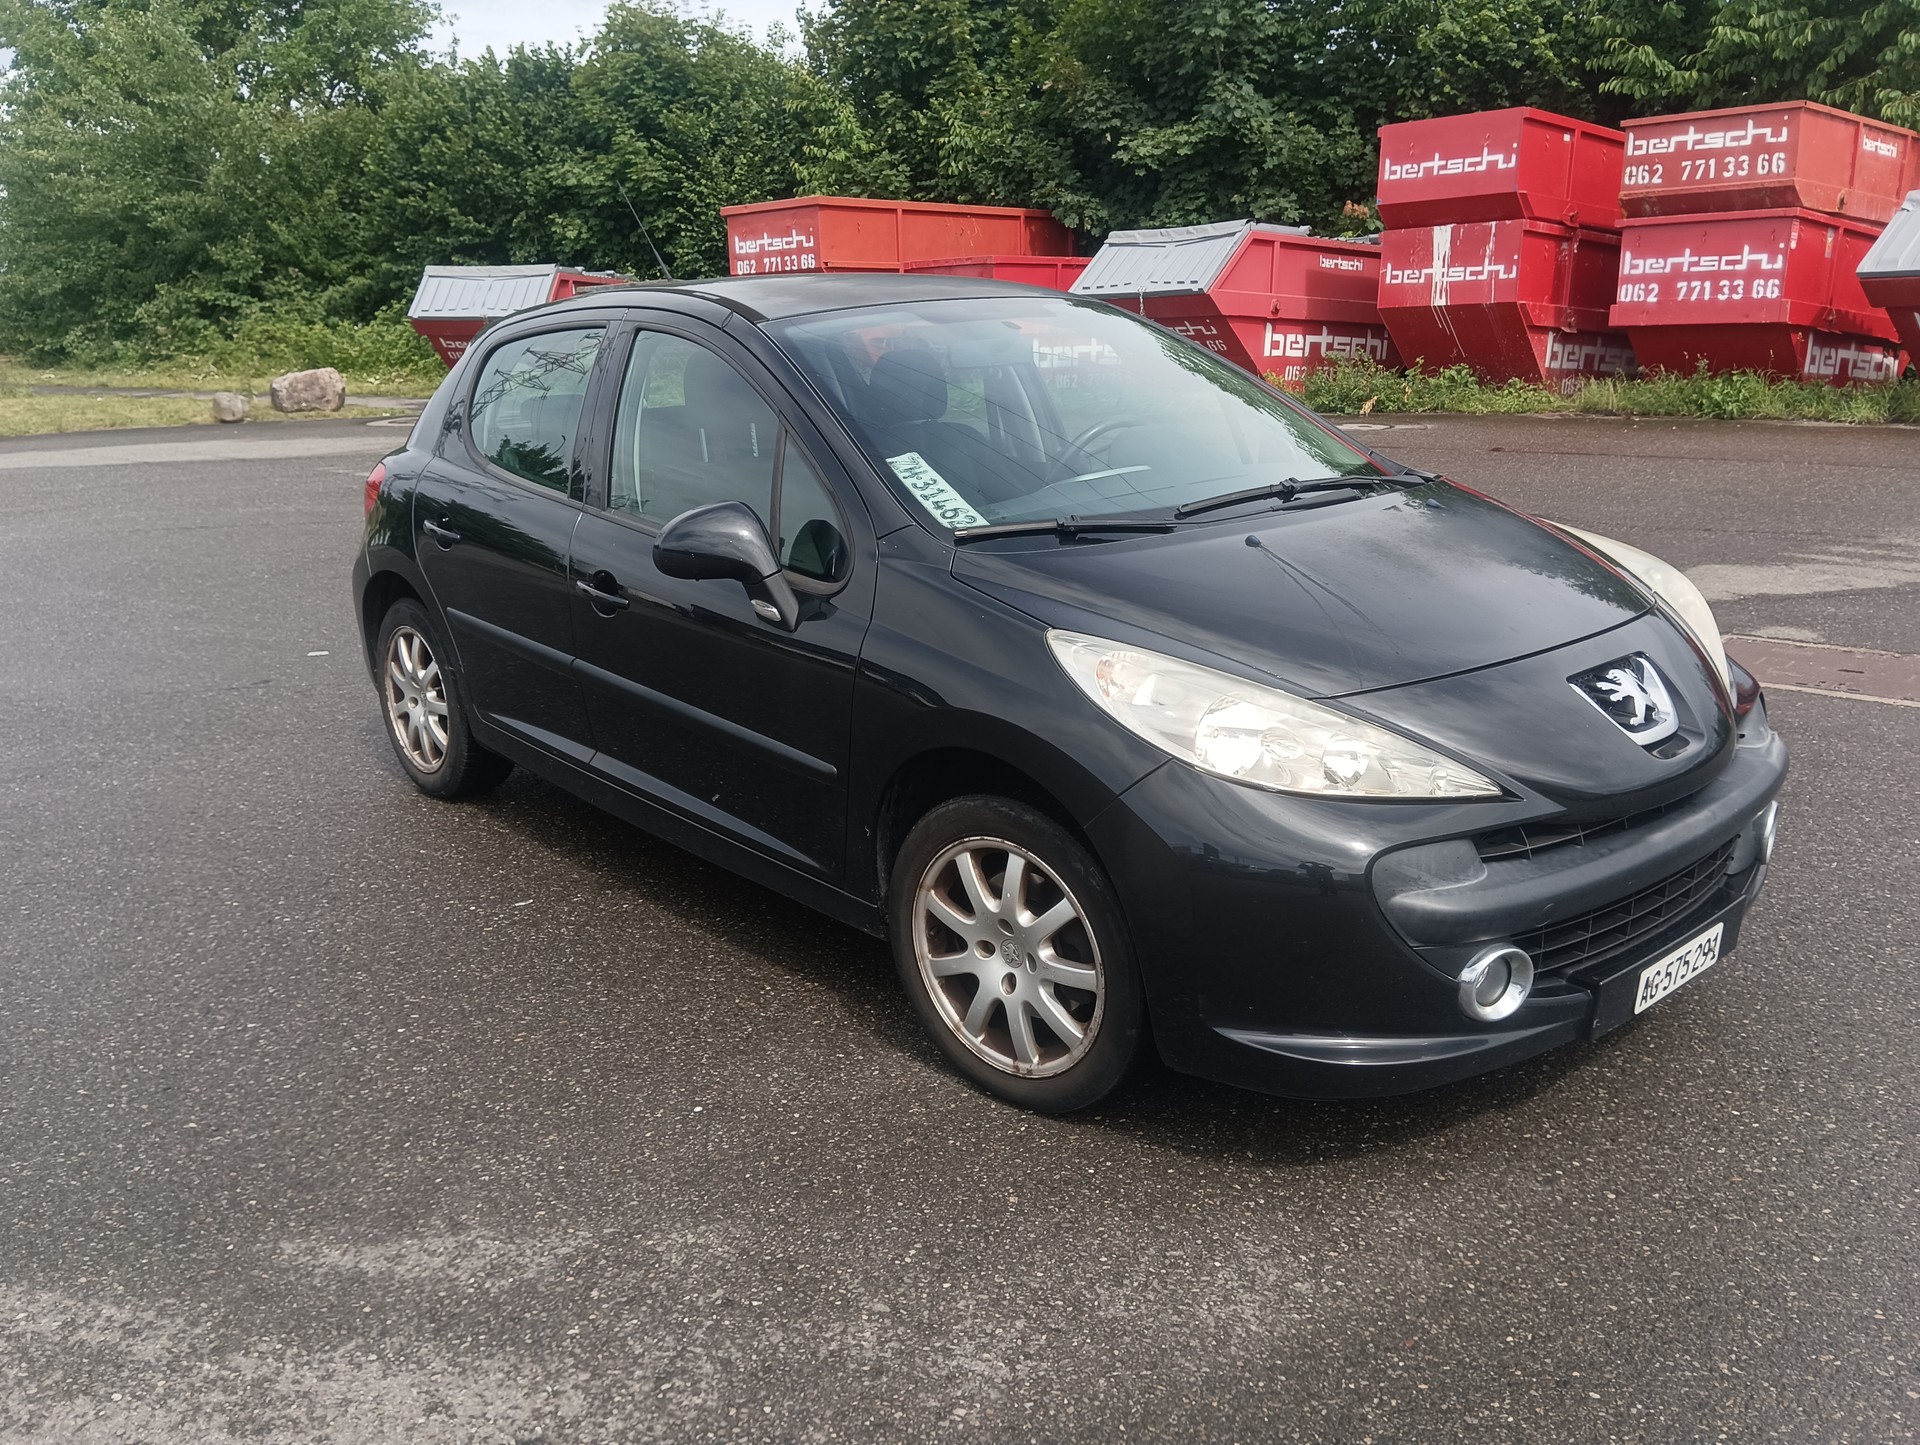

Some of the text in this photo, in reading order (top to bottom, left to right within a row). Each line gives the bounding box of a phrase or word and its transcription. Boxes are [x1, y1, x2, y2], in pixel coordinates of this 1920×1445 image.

[1626, 115, 1788, 156] bertschi
[1863, 134, 1898, 159] bertschi
[1384, 142, 1518, 181] bertschi
[1624, 152, 1786, 186] 062 771 33 66
[735, 227, 815, 255] bertschi
[736, 253, 816, 275] 062 771 33 66
[1319, 254, 1363, 272] bertschi
[1385, 254, 1519, 285] bertschi
[1623, 242, 1784, 275] bertschi
[1619, 278, 1780, 303] 062 771 33 66
[1263, 322, 1389, 360] bertschi
